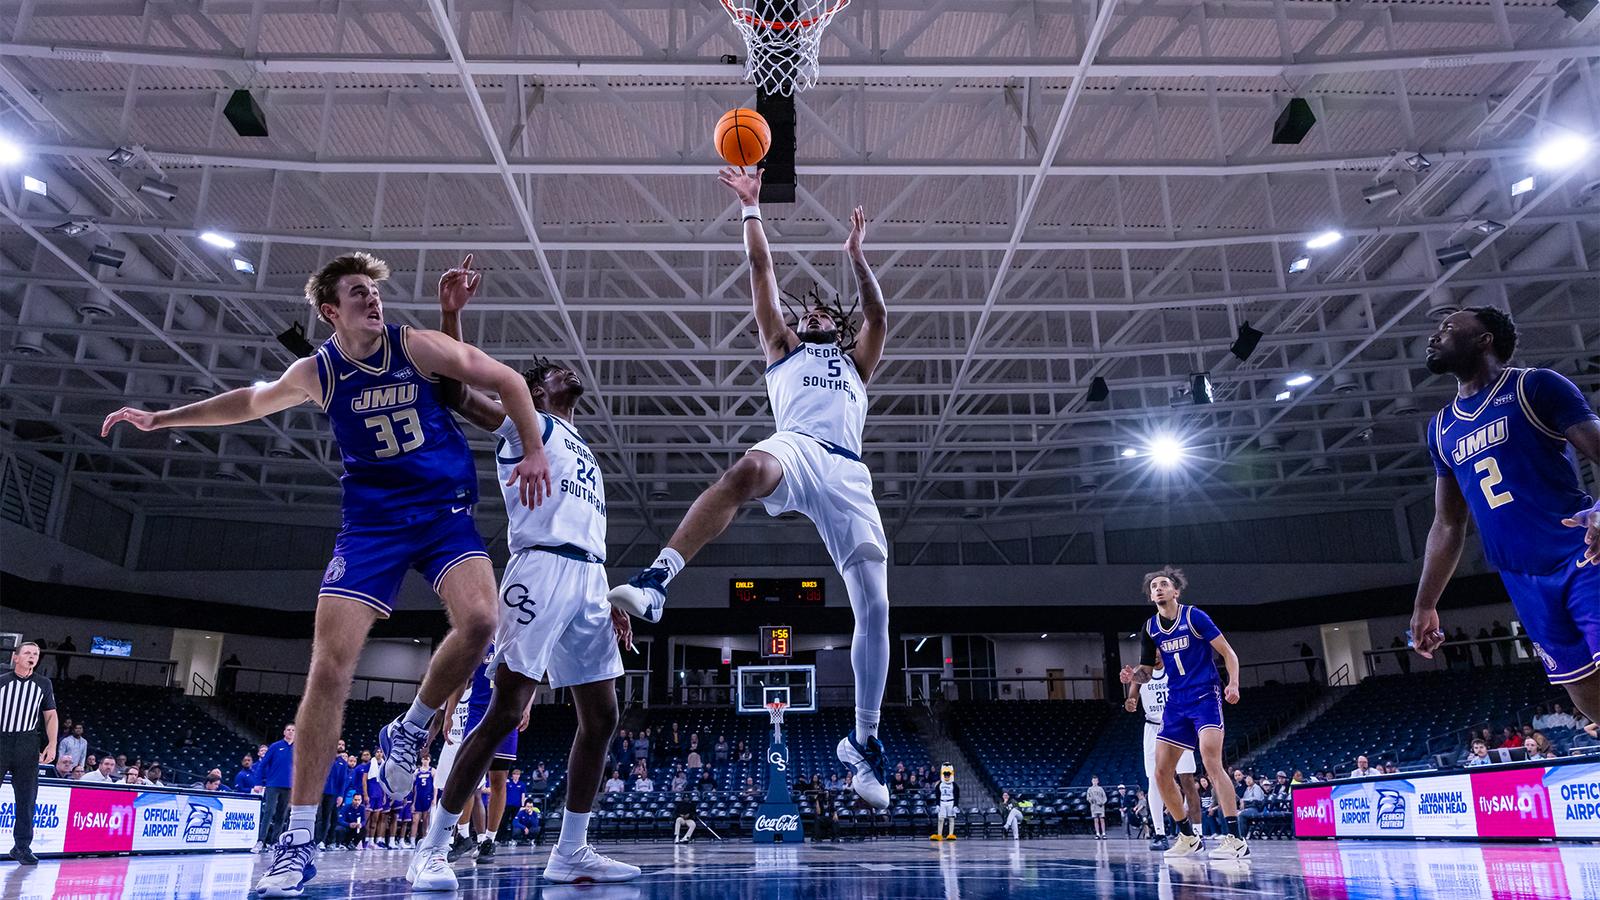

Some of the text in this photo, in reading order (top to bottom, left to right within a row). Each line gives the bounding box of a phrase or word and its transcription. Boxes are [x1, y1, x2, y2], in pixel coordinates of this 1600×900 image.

[806, 347, 842, 358] GEOR
[827, 359, 841, 378] 5
[353, 383, 416, 411] JMU
[364, 407, 425, 458] 33
[1454, 420, 1505, 463] JMU
[576, 456, 597, 492] 24
[1473, 456, 1515, 510] 2
[772, 629, 789, 638] 1:56
[772, 639, 786, 654] 13
[1161, 637, 1188, 651] JMU
[1173, 652, 1186, 676] 1
[1155, 691, 1167, 704] 21
[1420, 791, 1463, 804] SAVANNAH
[1560, 782, 1600, 801] OFFIC
[1339, 797, 1370, 810] OFFICIAL
[1418, 802, 1468, 815] HILTON HEAD
[32, 815, 59, 829] HEAD
[143, 808, 180, 822] OFFICIAL
[225, 812, 254, 821] SAVANNAH
[1341, 811, 1370, 824] AIRPORT
[142, 823, 179, 837] AIRPORT
[221, 820, 256, 830] HILTON HEAD
[755, 814, 799, 832] Coca-Cola
